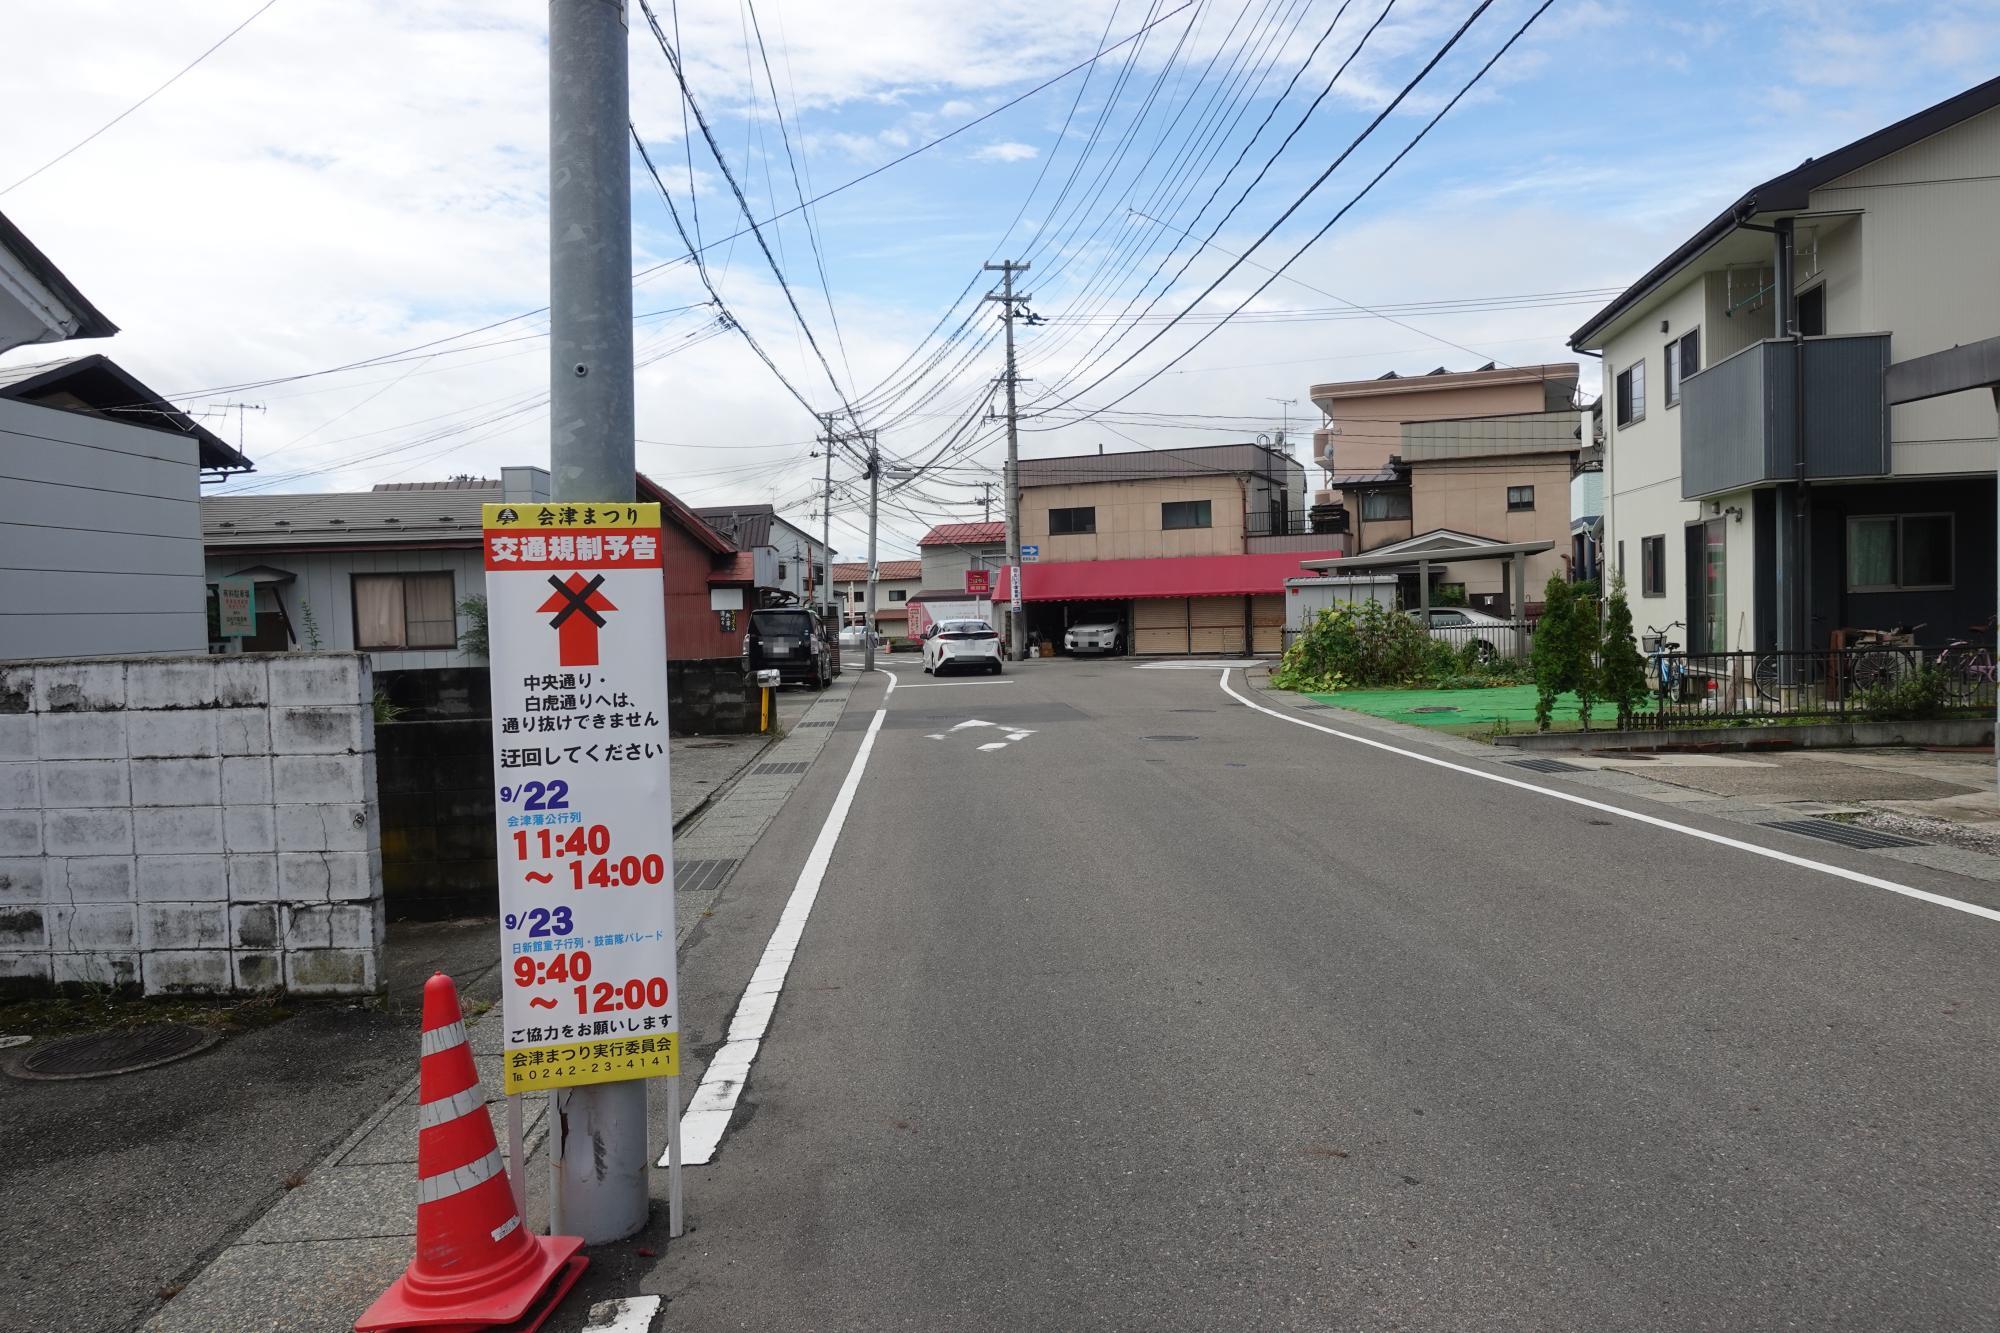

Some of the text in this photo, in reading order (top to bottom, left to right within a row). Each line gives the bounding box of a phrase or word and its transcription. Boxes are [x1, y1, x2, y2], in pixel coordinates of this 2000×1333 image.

[537, 506, 638, 526] 会津まつり
[490, 535, 657, 562] 交通規制予告
[525, 692, 637, 713] 白虎通りへは、
[502, 711, 659, 734] 通り抜けできません
[501, 743, 663, 768] 迂回してください
[500, 779, 569, 811] 9/22
[508, 811, 582, 828] 会津藩公行列
[513, 824, 611, 861] 11:40
[505, 906, 574, 938] 9/23
[513, 951, 592, 987] 9:40
[511, 1014, 673, 1043] ご協力をお願いします
[511, 1037, 672, 1068] 会津まつり実行委員会
[528, 1055, 671, 1081] 0242-23-4141
